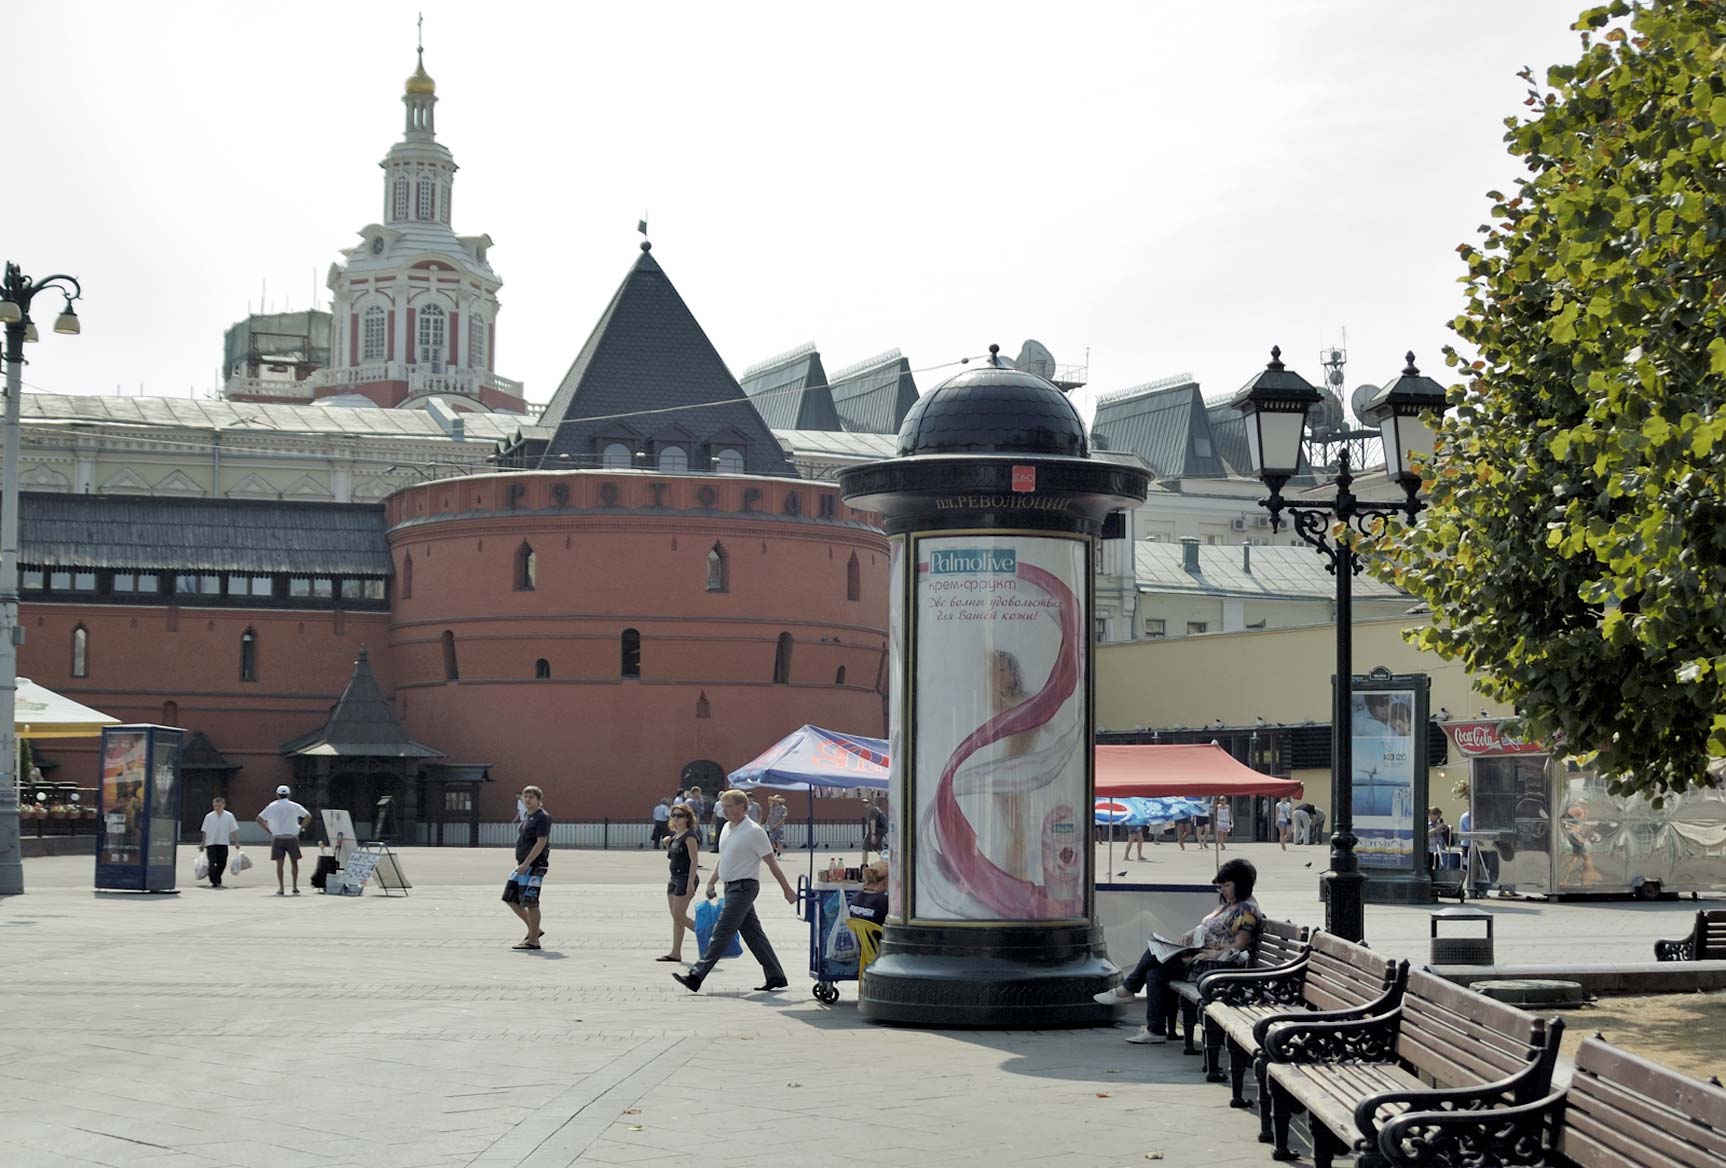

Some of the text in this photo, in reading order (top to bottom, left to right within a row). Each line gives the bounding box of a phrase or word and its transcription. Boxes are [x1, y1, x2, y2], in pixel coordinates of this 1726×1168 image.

[931, 552, 1015, 573] Palmolive
[949, 596, 985, 608] волны
[936, 610, 1039, 622] для Вашей кожи!
